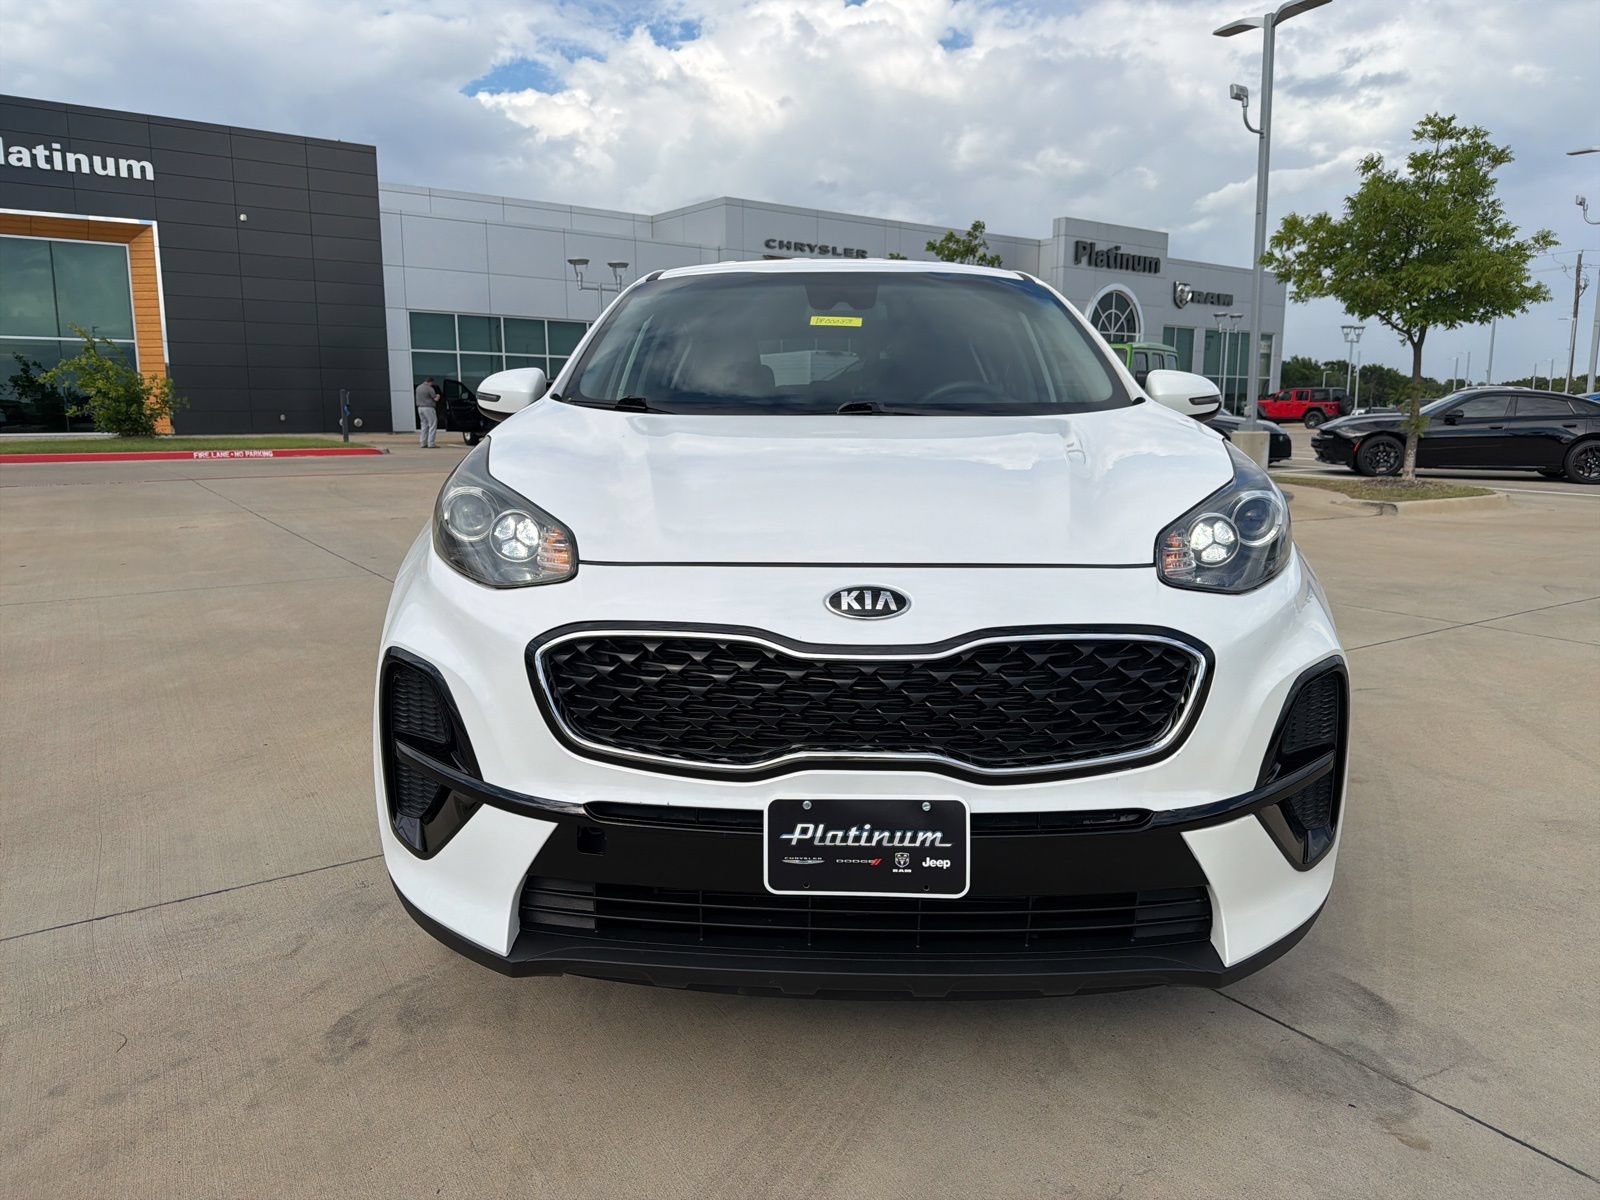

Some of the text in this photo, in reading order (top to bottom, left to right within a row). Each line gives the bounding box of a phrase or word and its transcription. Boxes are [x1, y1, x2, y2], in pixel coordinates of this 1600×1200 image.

[764, 238, 868, 259] CHRYSLER
[1074, 240, 1161, 274] Platinum
[1191, 290, 1234, 306] RAM
[193, 451, 209, 459] FIRE
[840, 590, 898, 611] KIA
[779, 823, 953, 847] Platinum
[922, 857, 951, 869] Jeep
